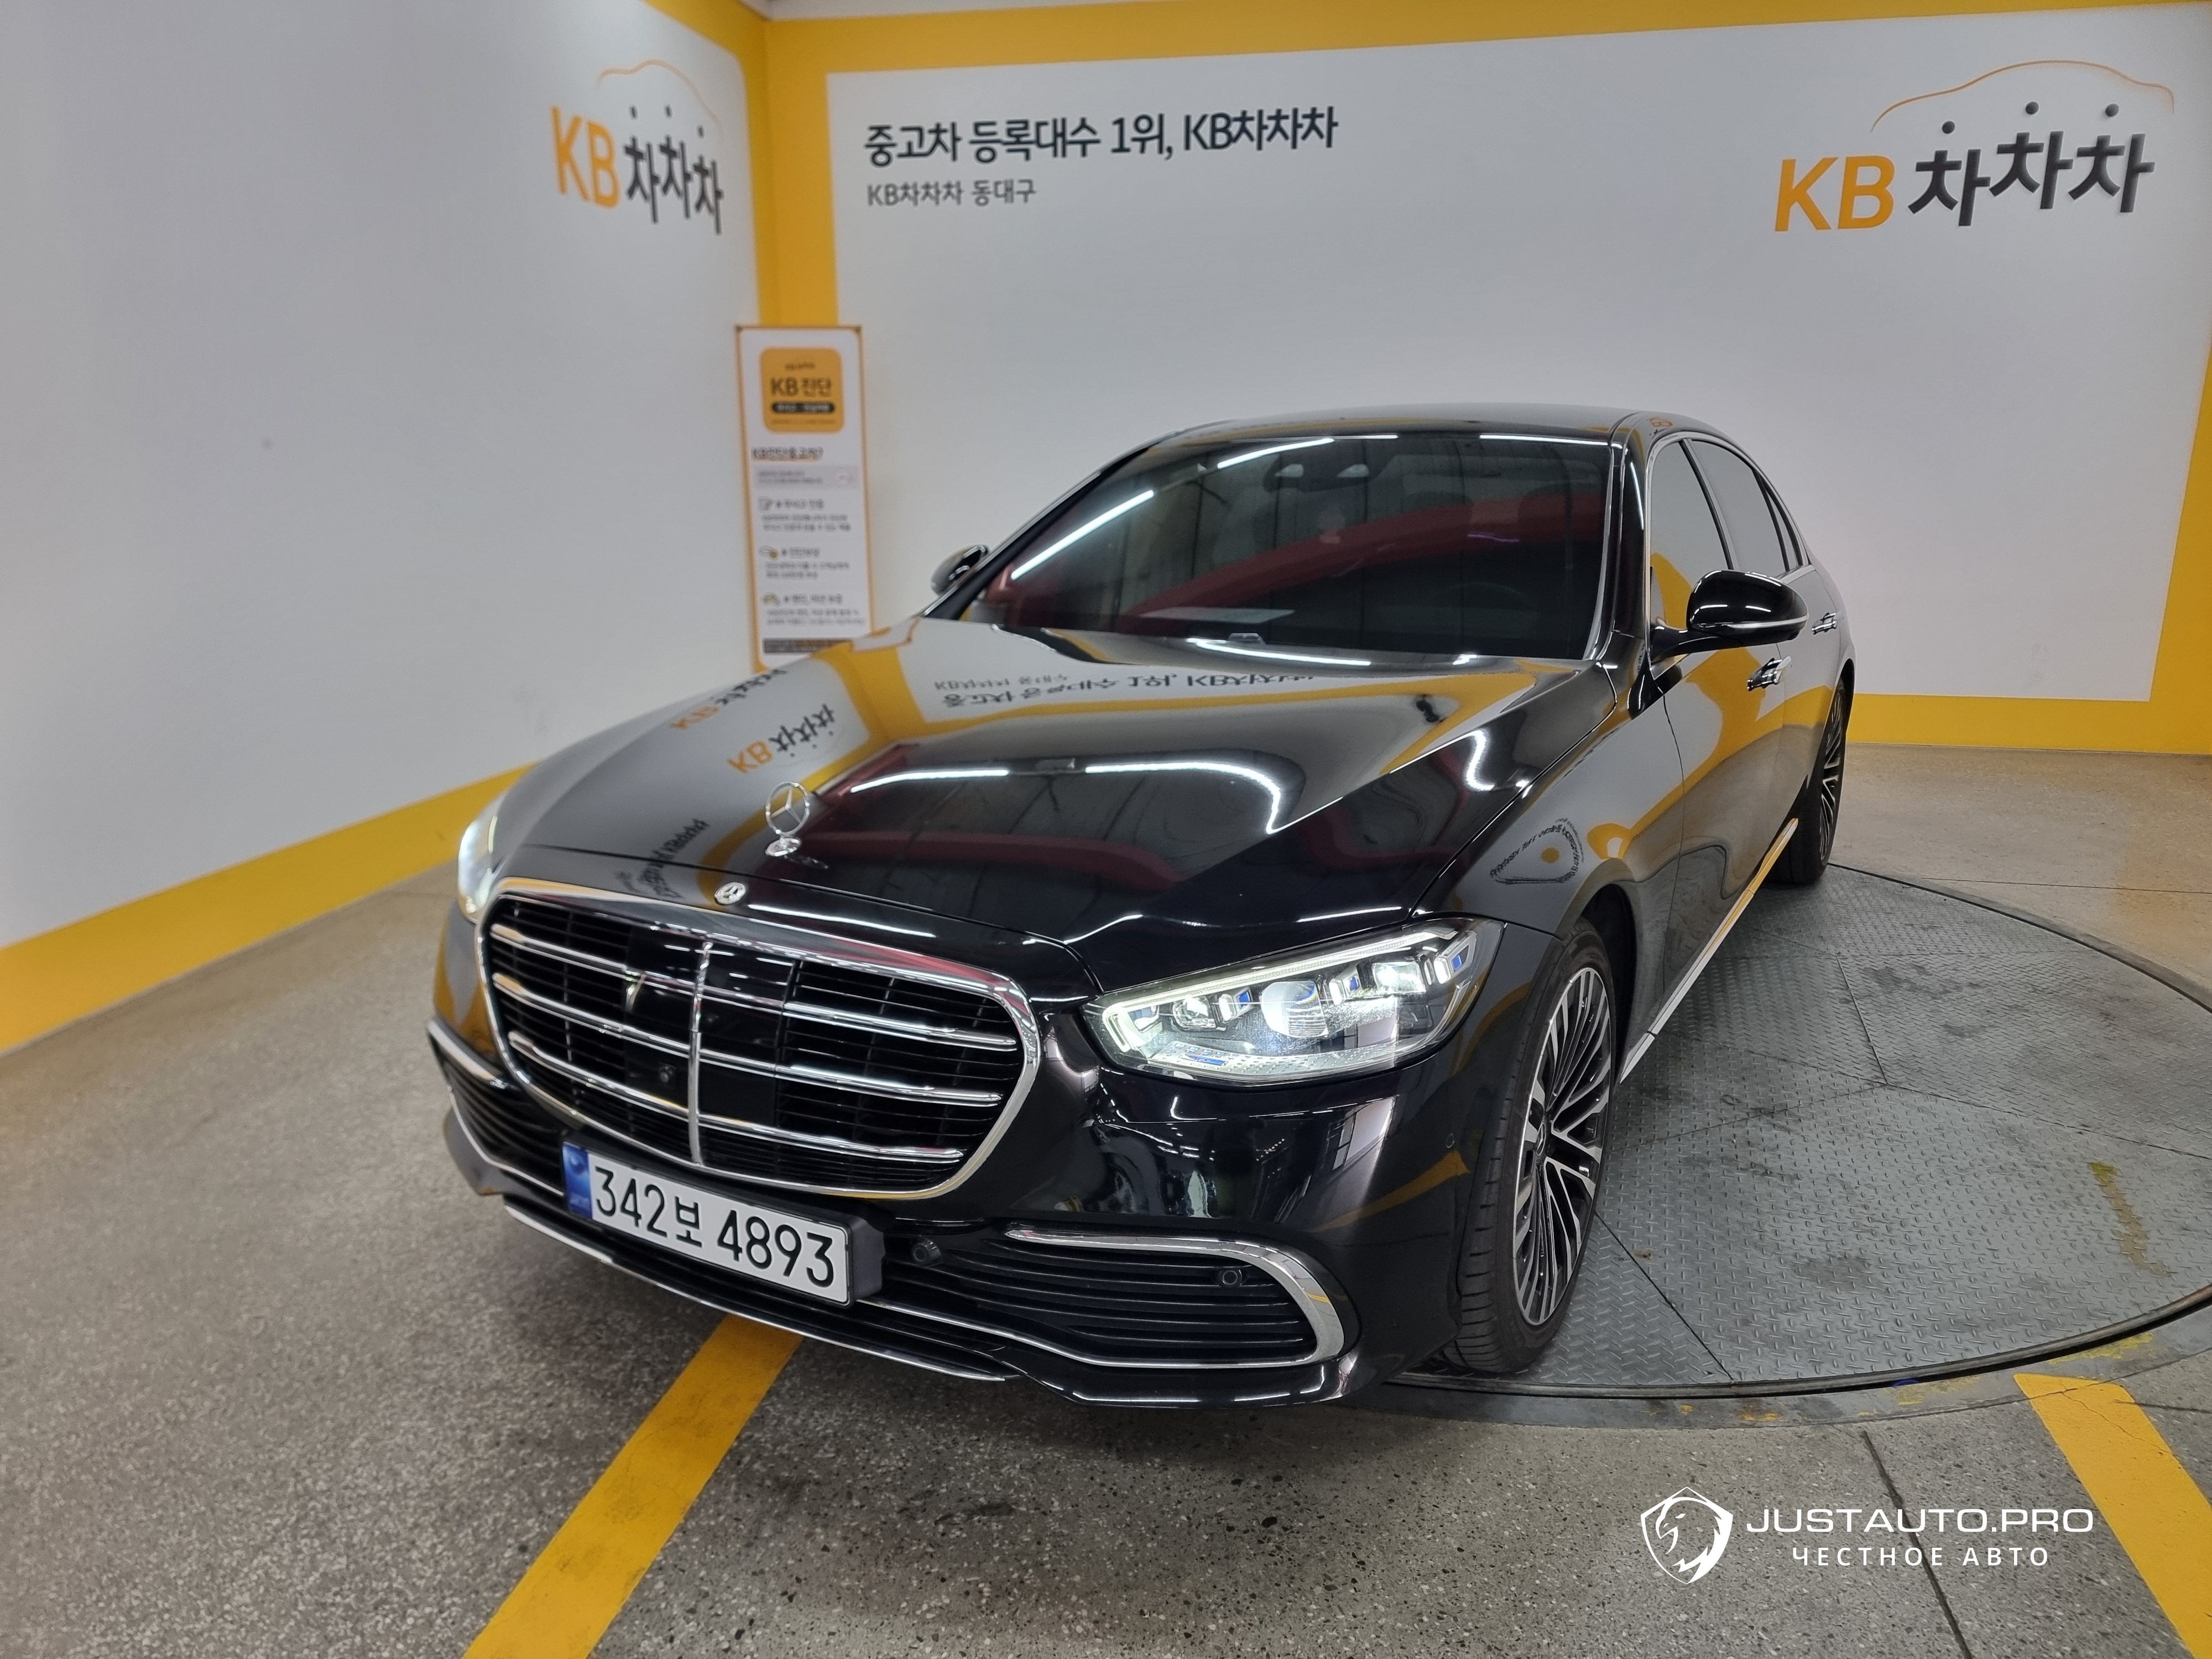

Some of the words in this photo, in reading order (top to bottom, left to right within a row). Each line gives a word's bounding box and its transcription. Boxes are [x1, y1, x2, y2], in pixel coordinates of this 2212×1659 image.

[864, 121, 962, 167] 중고차
[969, 117, 1101, 164] 등록대수
[1110, 113, 1173, 160] 1위,
[1183, 106, 1339, 151] KB차차차
[867, 180, 964, 206] KB차차차
[972, 178, 1037, 207] 동대구
[594, 1166, 702, 1248] 342보
[717, 1209, 834, 1288] 4893
